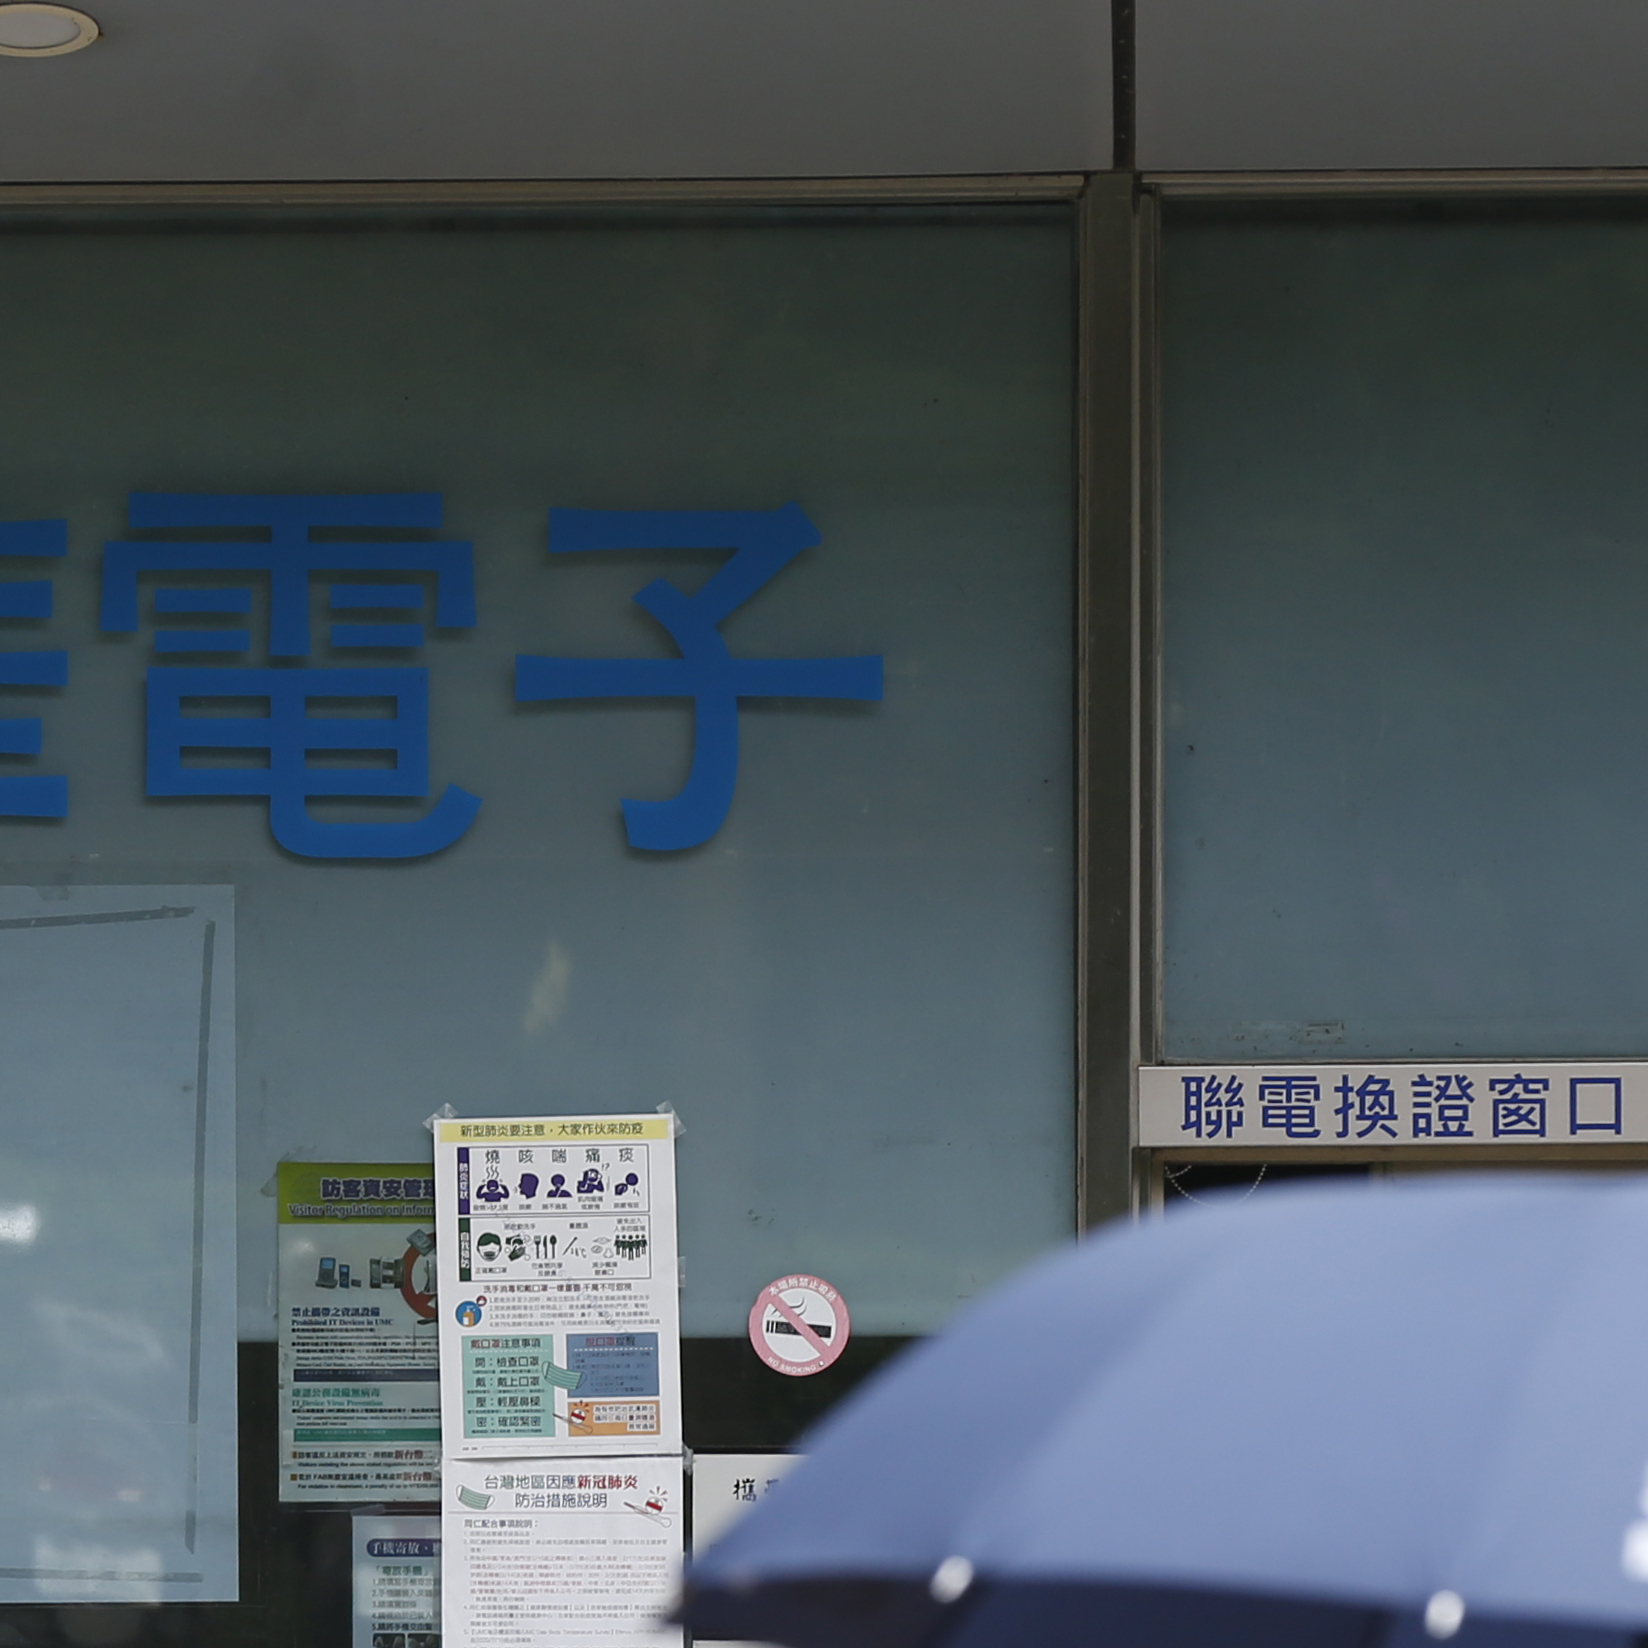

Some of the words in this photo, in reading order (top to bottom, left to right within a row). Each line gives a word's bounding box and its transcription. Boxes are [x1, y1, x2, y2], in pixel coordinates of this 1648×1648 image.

[1180, 1072, 1624, 1140] 聯電換證窗口
[288, 1203, 323, 1216] Visitor
[325, 1203, 383, 1218] Regulation
[385, 1206, 400, 1216] on
[515, 1492, 608, 1508] 防治措施說明
